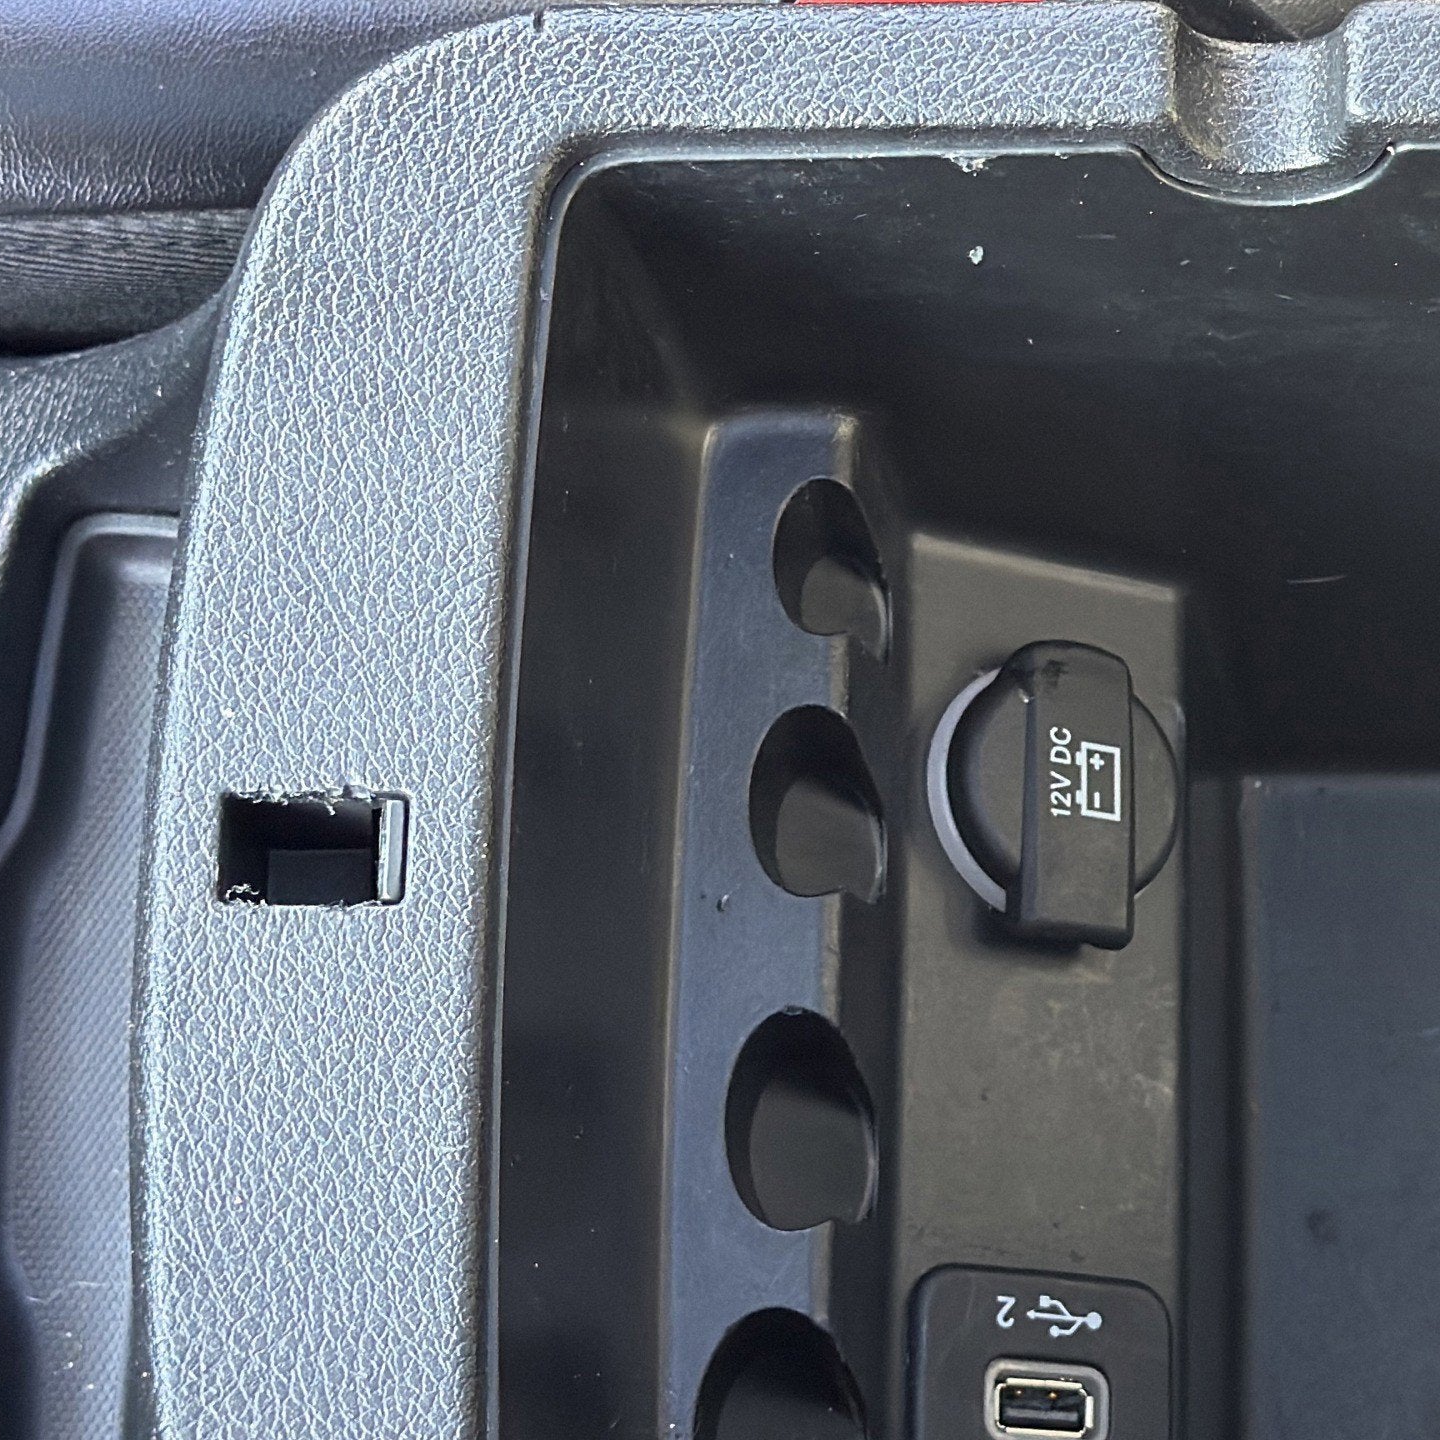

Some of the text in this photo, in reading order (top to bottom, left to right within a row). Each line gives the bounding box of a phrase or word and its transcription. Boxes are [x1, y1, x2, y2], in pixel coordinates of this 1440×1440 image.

[1049, 725, 1072, 817] 12V DC
[996, 1295, 1016, 1329] 2
